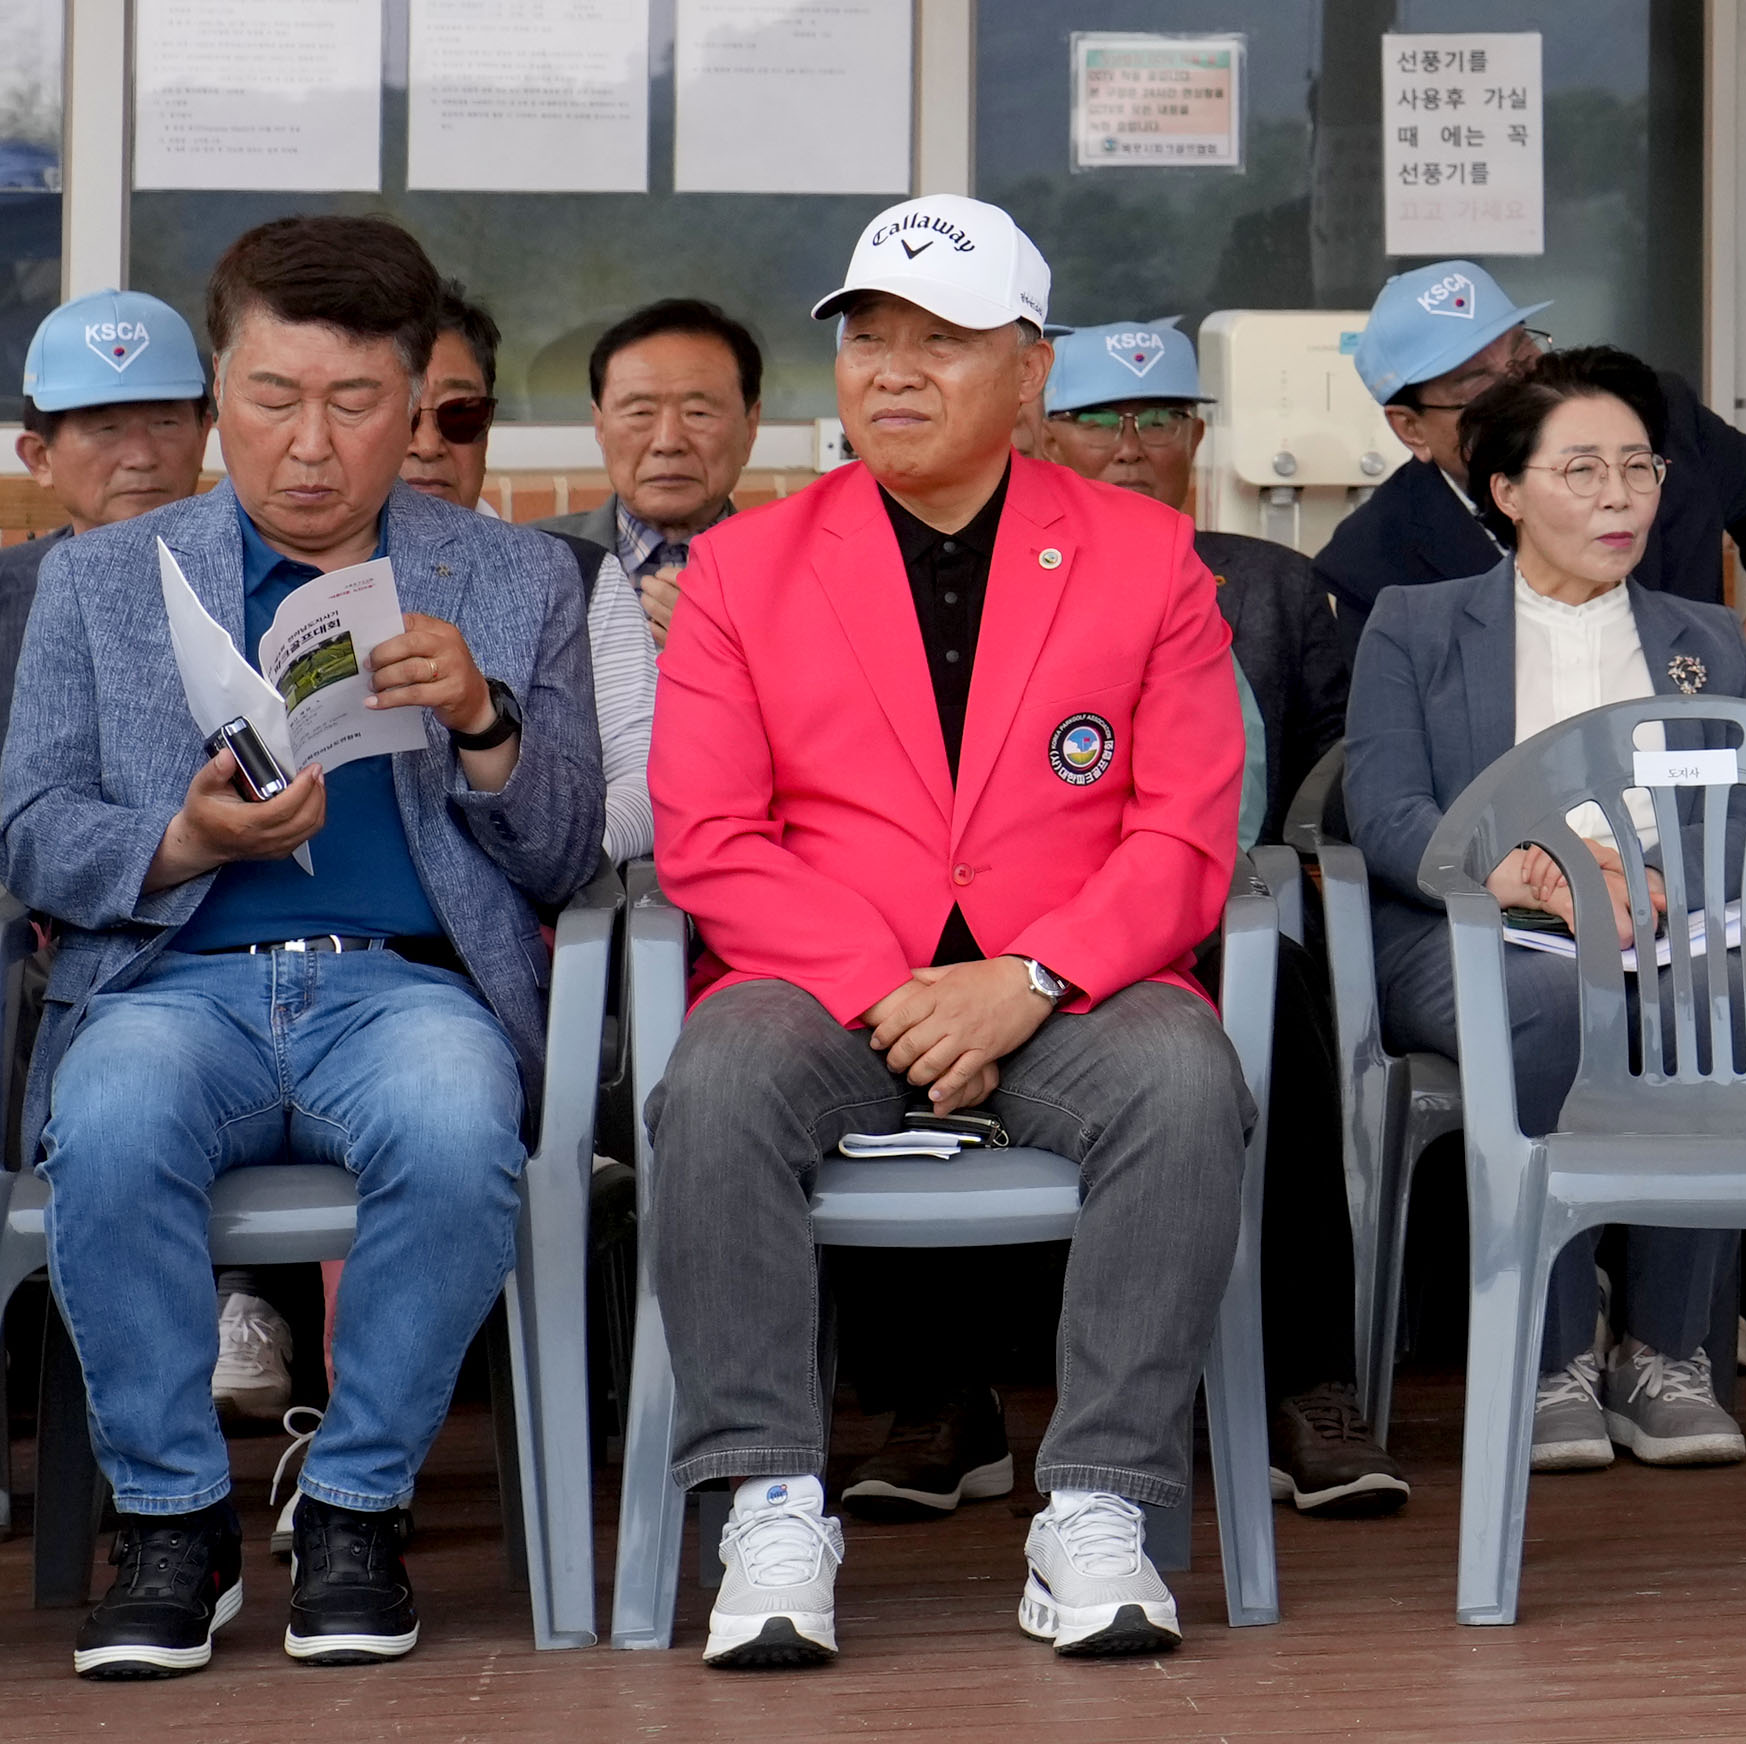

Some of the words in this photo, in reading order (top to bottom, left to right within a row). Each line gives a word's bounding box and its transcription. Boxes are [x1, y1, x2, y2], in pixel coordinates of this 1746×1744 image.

[1397, 49, 1489, 74] 선풍기를
[1398, 87, 1465, 111] 사용후
[1484, 86, 1527, 110] 가실
[1398, 125, 1419, 148] 때
[1440, 125, 1485, 148] 에는
[1507, 124, 1529, 147] 꼭
[1398, 162, 1489, 186] 선풍기를
[872, 212, 975, 255] Callaway
[1417, 272, 1471, 312] KSCA
[85, 322, 150, 342] KSCA
[1105, 332, 1165, 351] KSCA
[1667, 767, 1700, 779] 도지사
